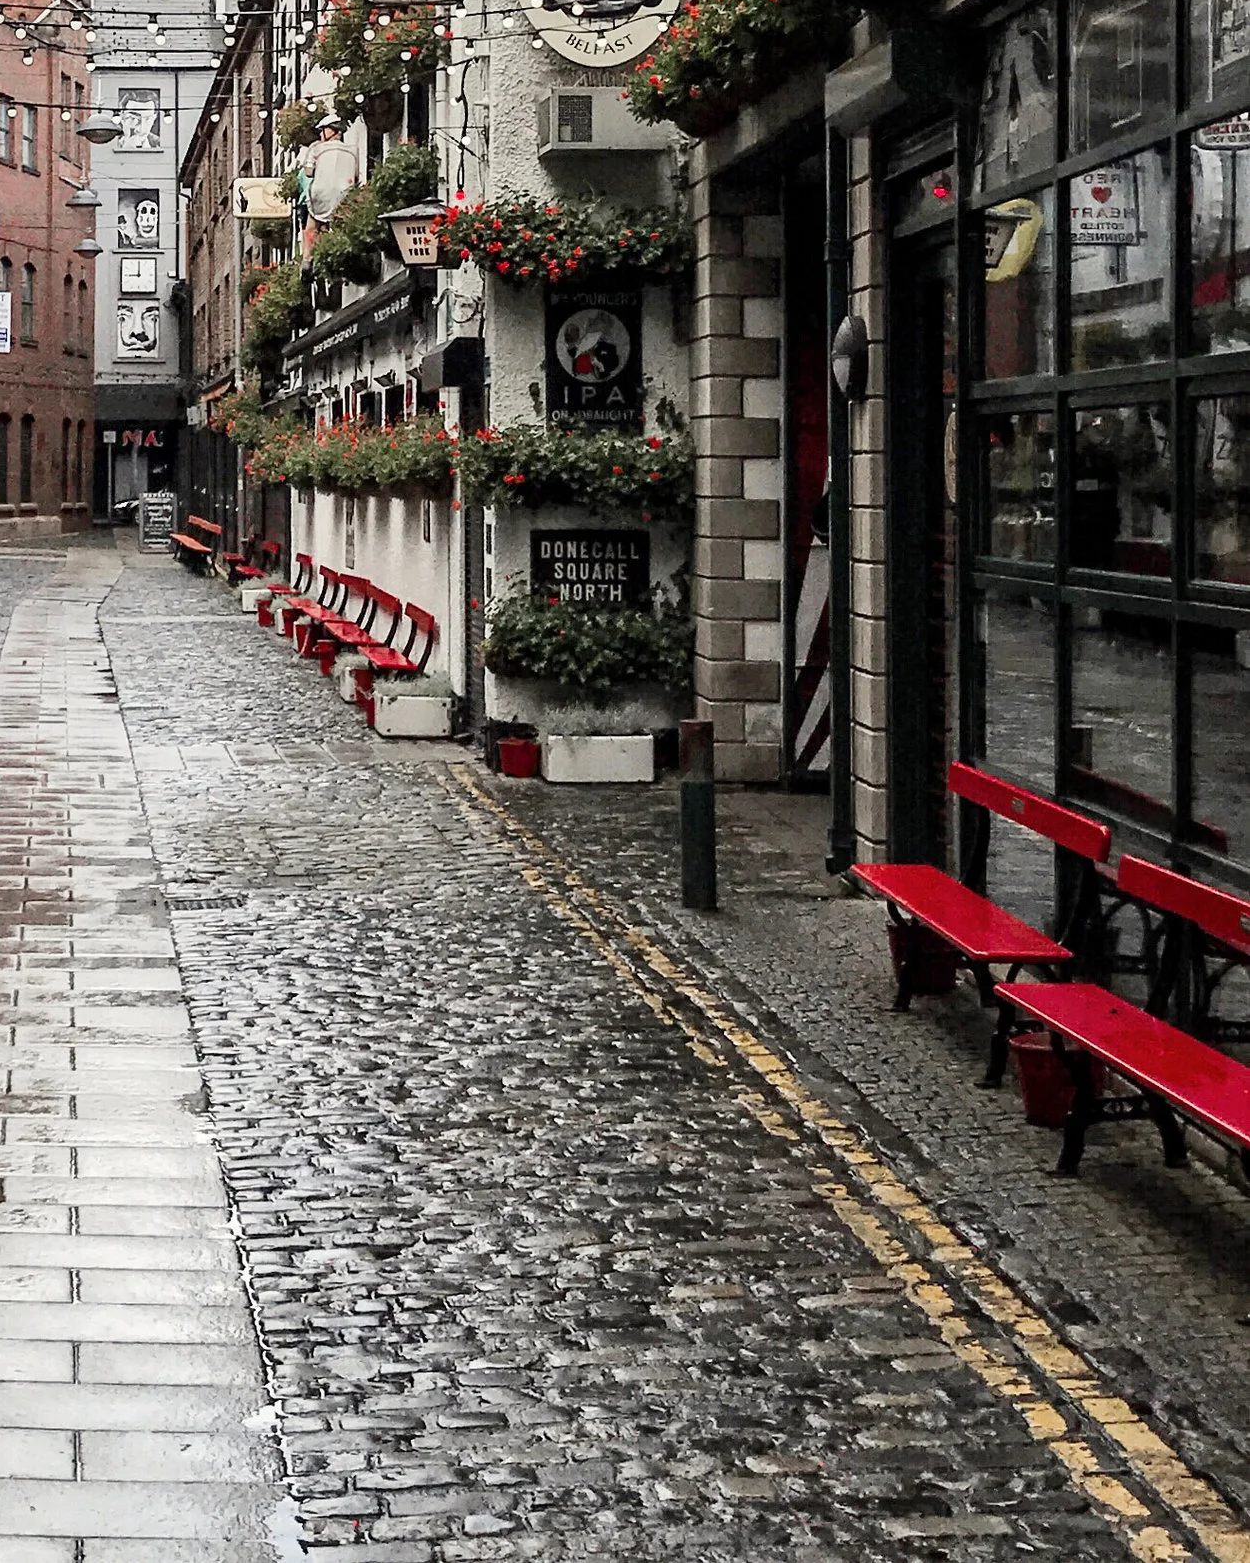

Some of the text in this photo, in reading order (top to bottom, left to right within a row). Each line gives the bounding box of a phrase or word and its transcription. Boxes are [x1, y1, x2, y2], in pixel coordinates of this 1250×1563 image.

[565, 33, 634, 55] BELFAST
[541, 541, 639, 559] DONEGALL
[554, 563, 627, 580] SQUARE
[560, 583, 621, 601] NORTH
